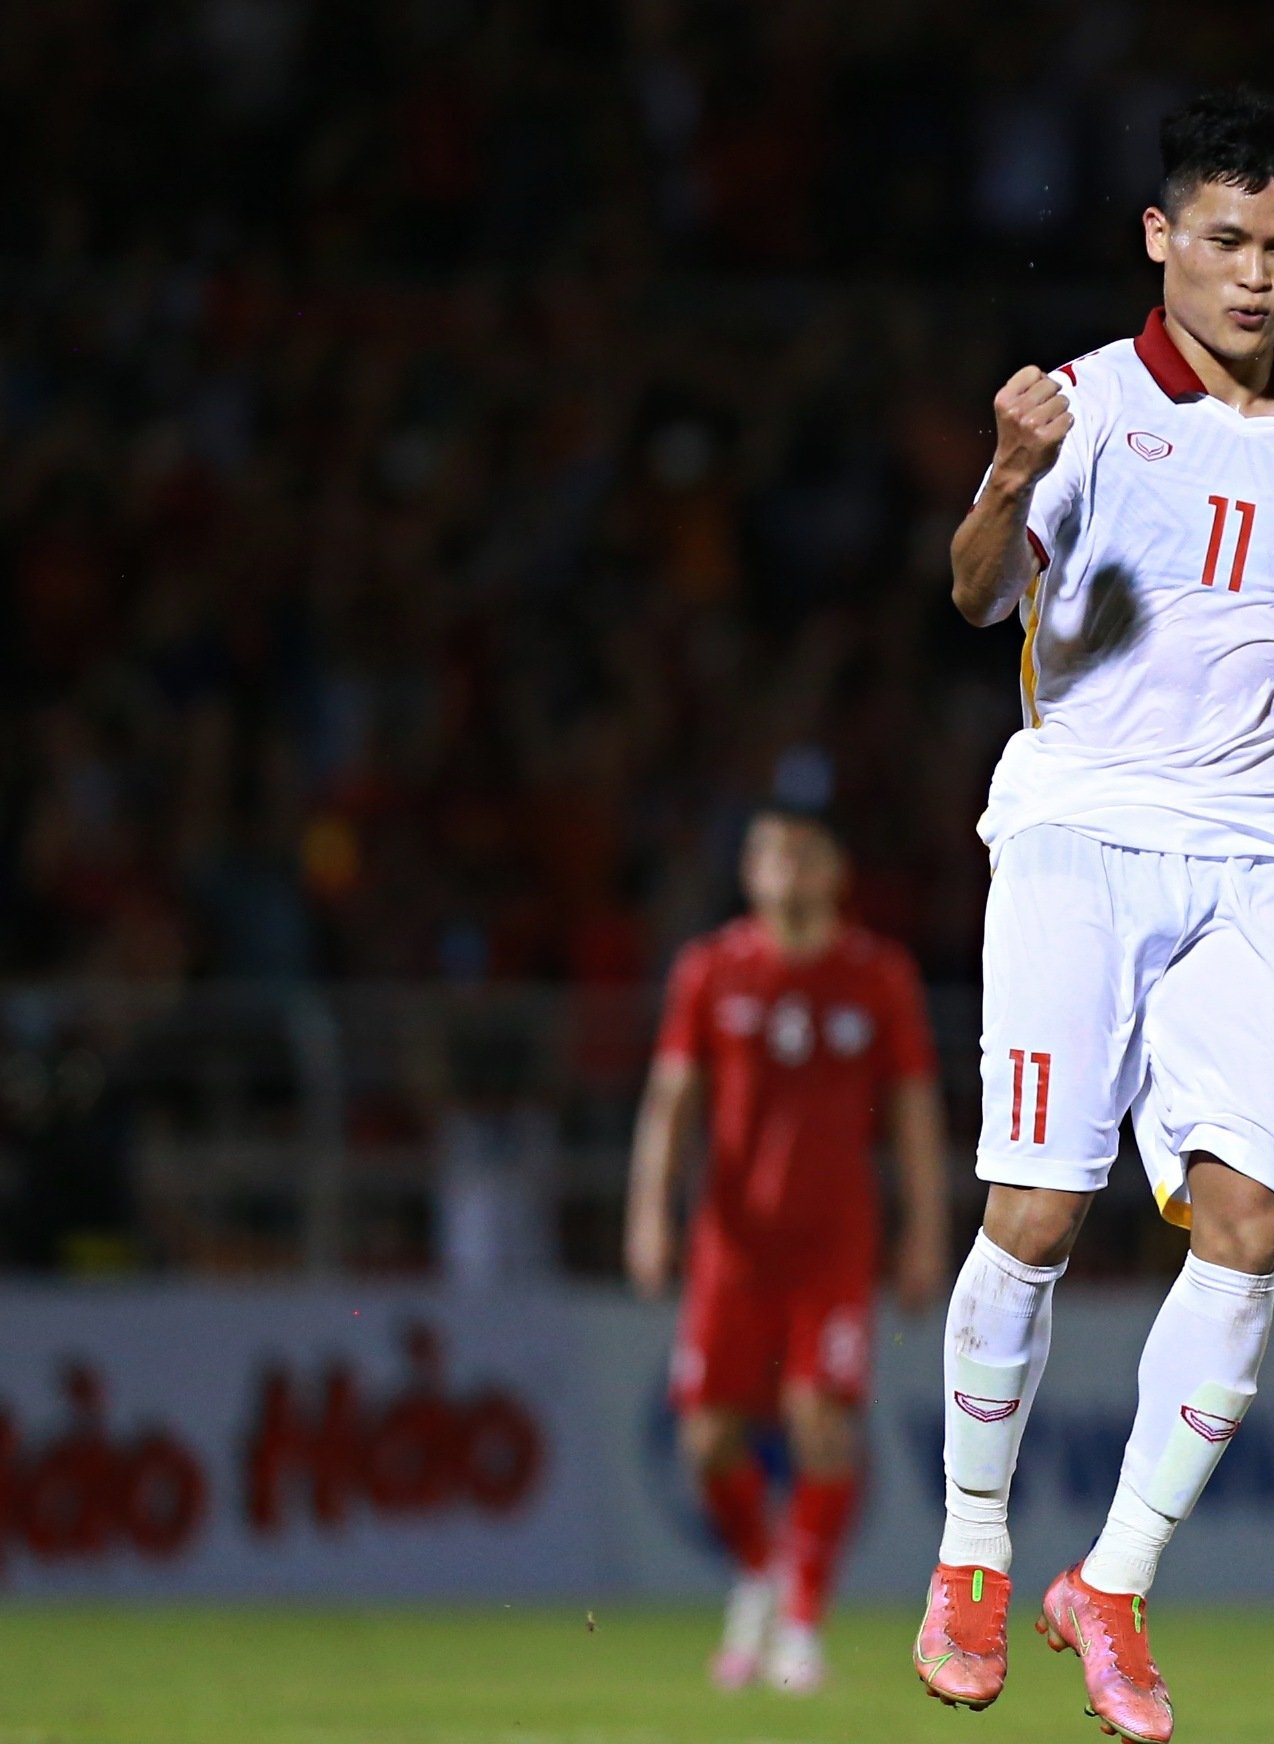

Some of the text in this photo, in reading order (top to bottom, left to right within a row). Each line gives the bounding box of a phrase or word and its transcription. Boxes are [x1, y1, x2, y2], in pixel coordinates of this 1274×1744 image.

[1201, 495, 1256, 593] 11
[1009, 1049, 1051, 1145] 11
[0, 1362, 206, 1562] ảo
